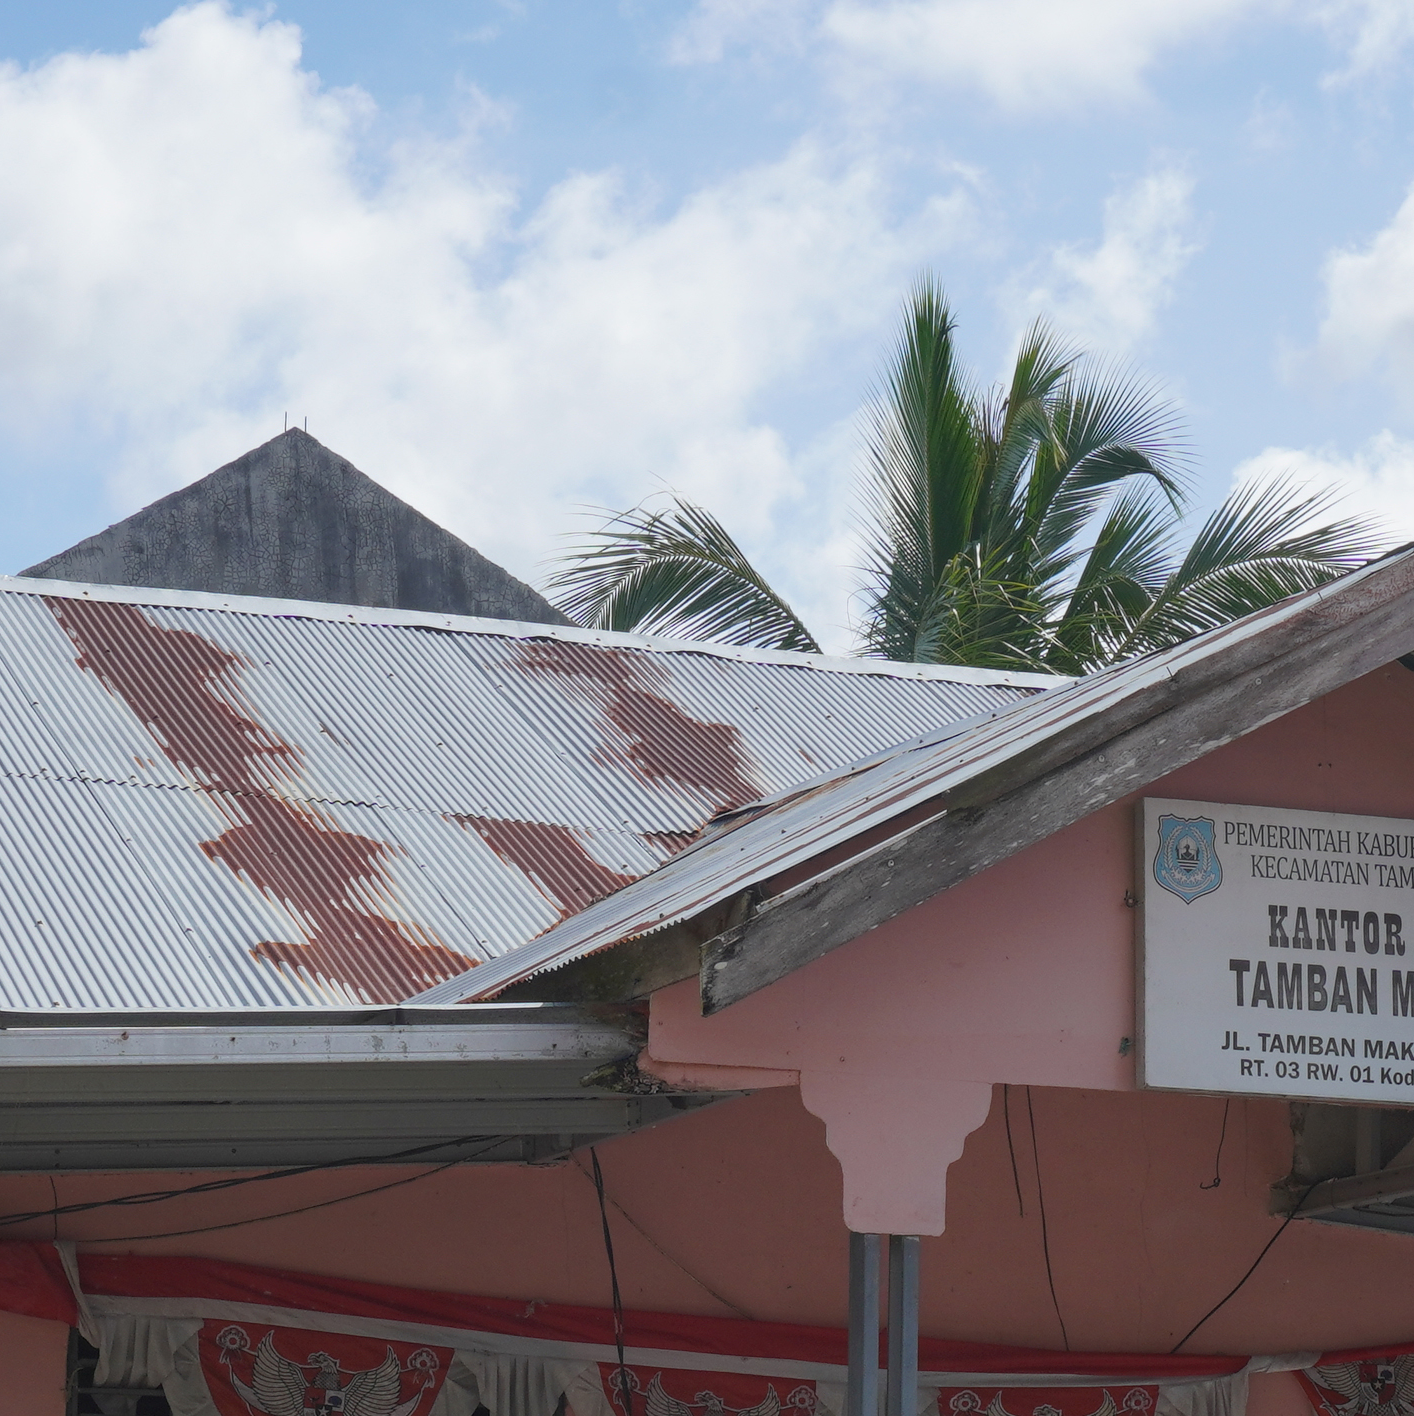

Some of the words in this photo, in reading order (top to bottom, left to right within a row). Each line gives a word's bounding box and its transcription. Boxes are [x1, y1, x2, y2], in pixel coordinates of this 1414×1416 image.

[1224, 821, 1351, 854] PEMERINTAH
[1251, 855, 1370, 885] KECAMATAN
[1268, 905, 1405, 956] KANTOR
[1229, 959, 1377, 1015] TAMBAN
[1222, 1030, 1250, 1051] JL.
[1258, 1033, 1355, 1058] TAMBAN
[1240, 1059, 1269, 1078] RT.
[1276, 1061, 1300, 1080] 03
[1307, 1063, 1343, 1082] RW.
[1350, 1065, 1375, 1084] 01
